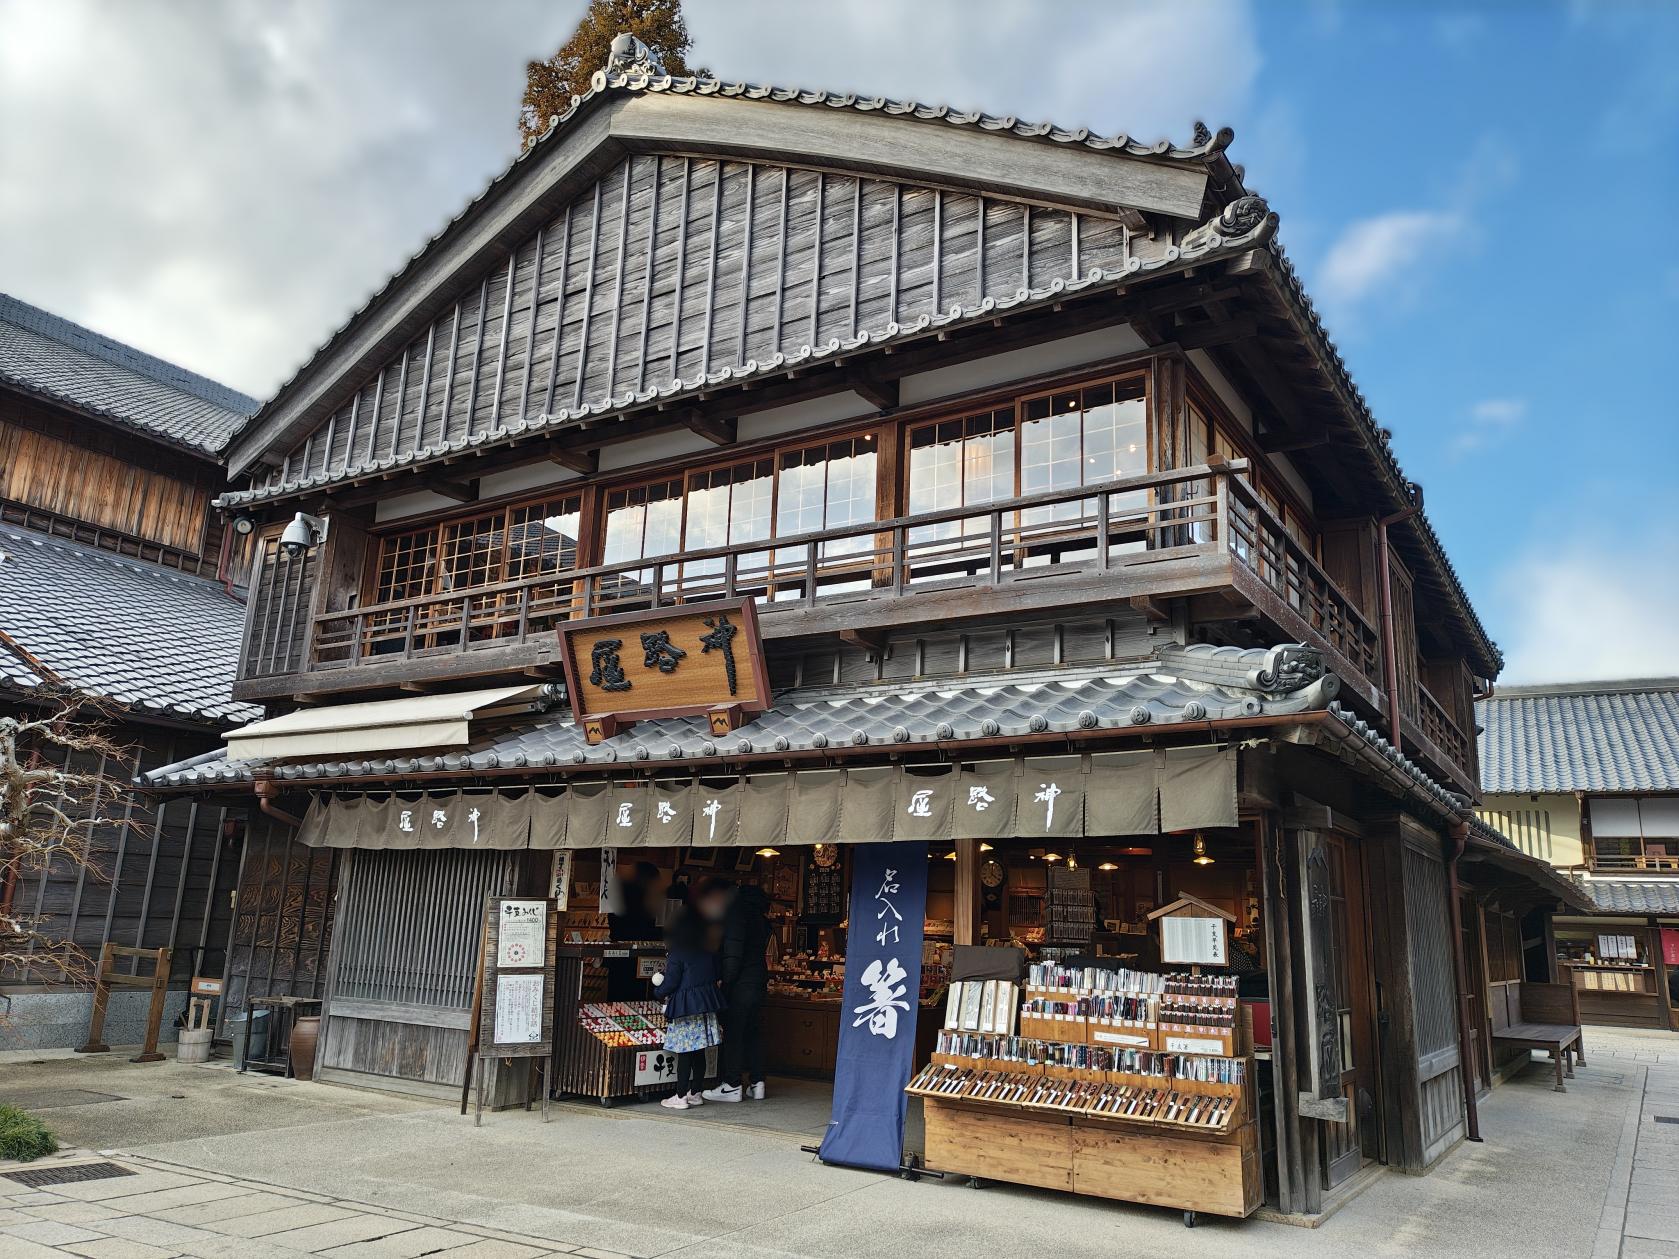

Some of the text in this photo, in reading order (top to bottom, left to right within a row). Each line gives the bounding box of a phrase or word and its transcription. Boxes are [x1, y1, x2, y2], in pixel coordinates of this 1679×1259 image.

[852, 867, 911, 1040] 名入れ 箸
